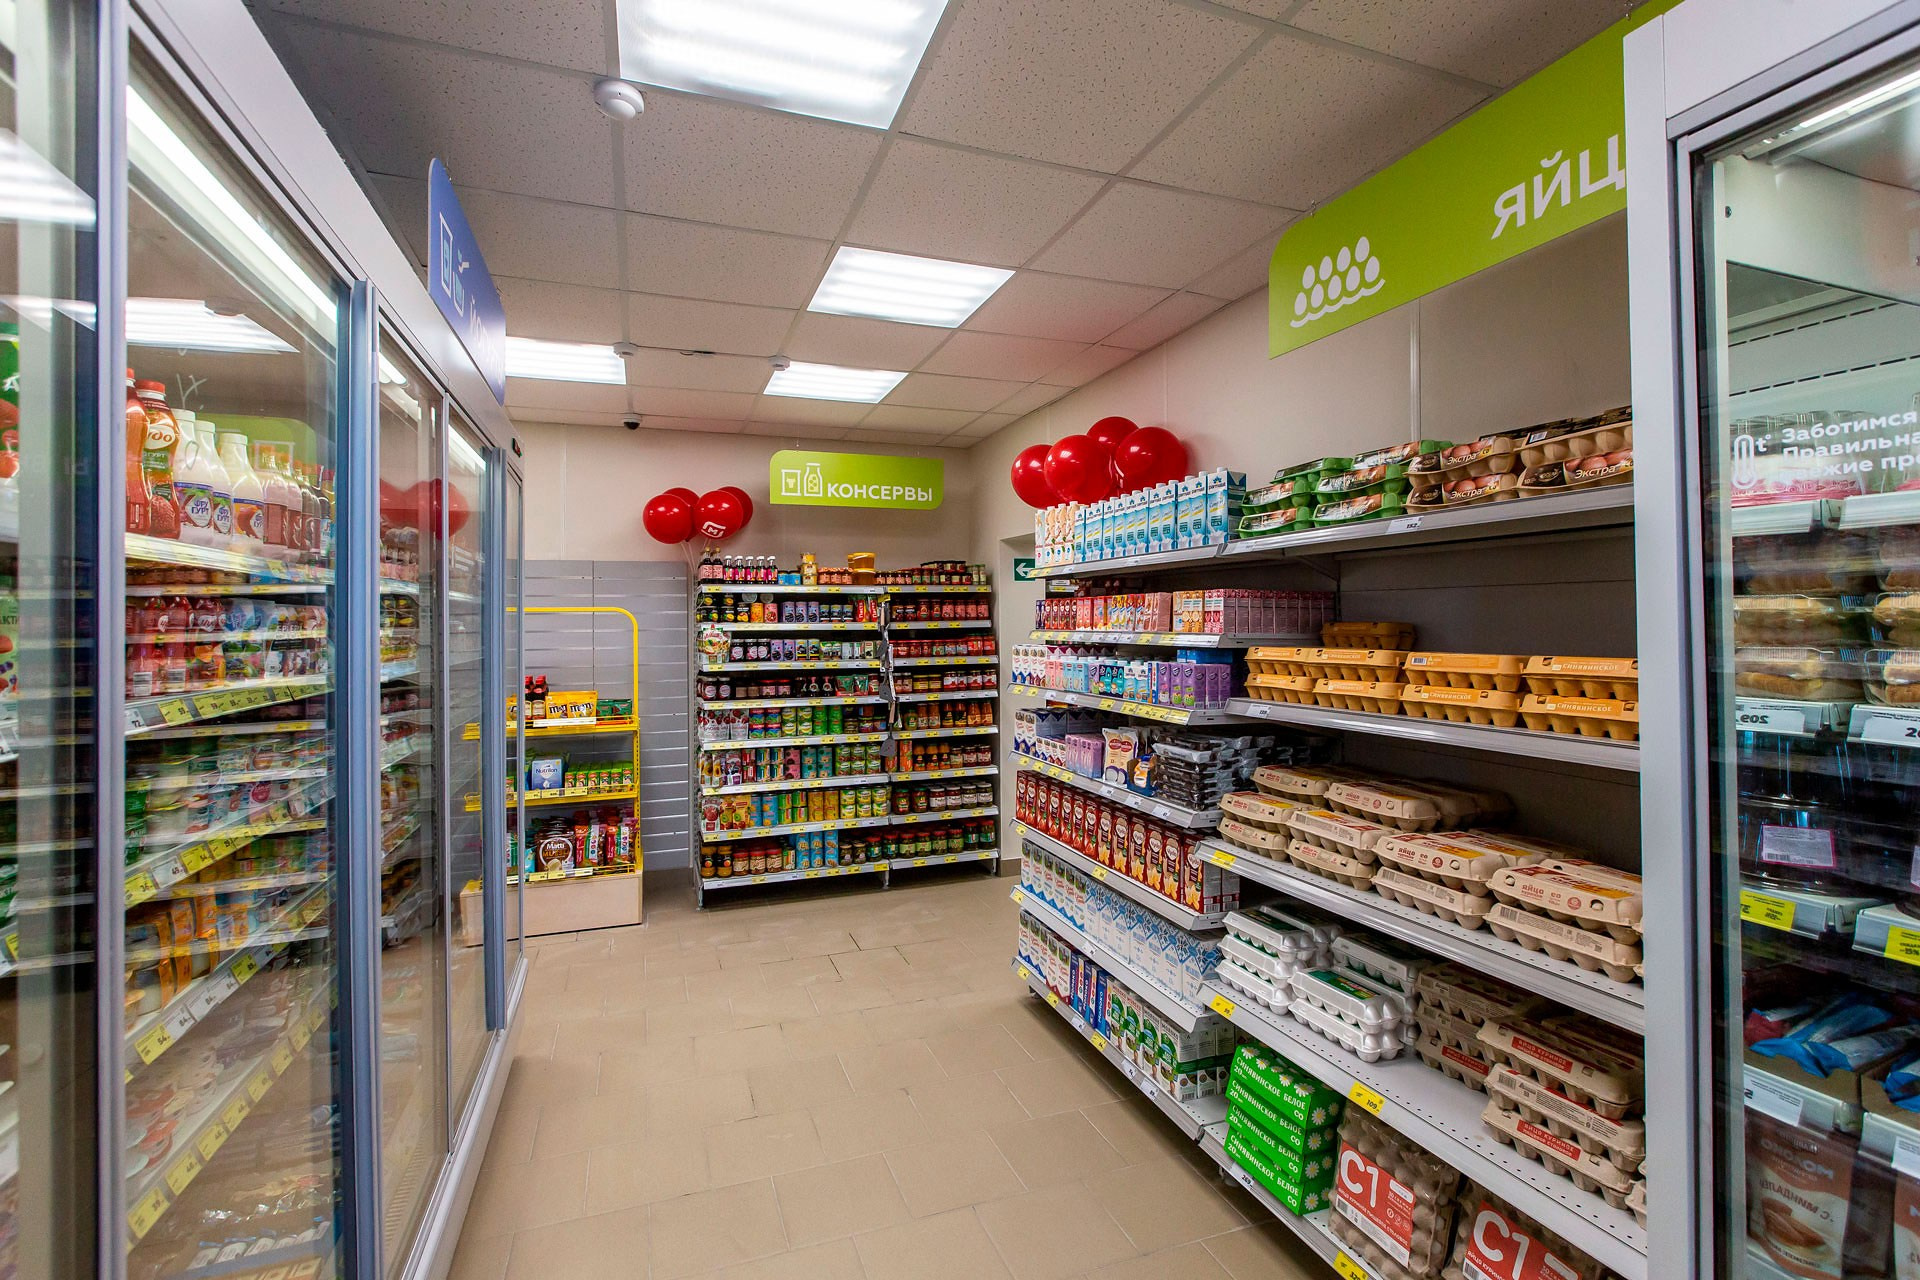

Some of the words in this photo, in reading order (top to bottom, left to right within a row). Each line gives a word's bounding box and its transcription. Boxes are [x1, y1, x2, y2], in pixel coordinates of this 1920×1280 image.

[1781, 411, 1917, 443] Заботимся
[1448, 453, 1478, 465] Экстра
[1575, 464, 1616, 479] Экстра
[827, 483, 932, 502] КОНСЕРВЫ
[1451, 487, 1483, 499] Экстра
[1562, 662, 1619, 671] СИНЯВИНСКОЕ
[1556, 702, 1612, 712] СИНЯВИНСКОЕ
[1237, 1056, 1281, 1097] СИНЯВИНСКОЕ
[1283, 1093, 1306, 1110] БЕЛОЕ
[1232, 1080, 1278, 1122] СИНЯВИНСКОЕ
[1279, 1118, 1302, 1135] БЕЛОЕ
[1232, 1105, 1276, 1148] СИНЯВИНСКОЕ
[1278, 1145, 1300, 1163] БЕЛОЕ
[1230, 1134, 1275, 1180] СИНЯВИНСКОЕ
[1277, 1177, 1299, 1196] БЕЛОЕ
